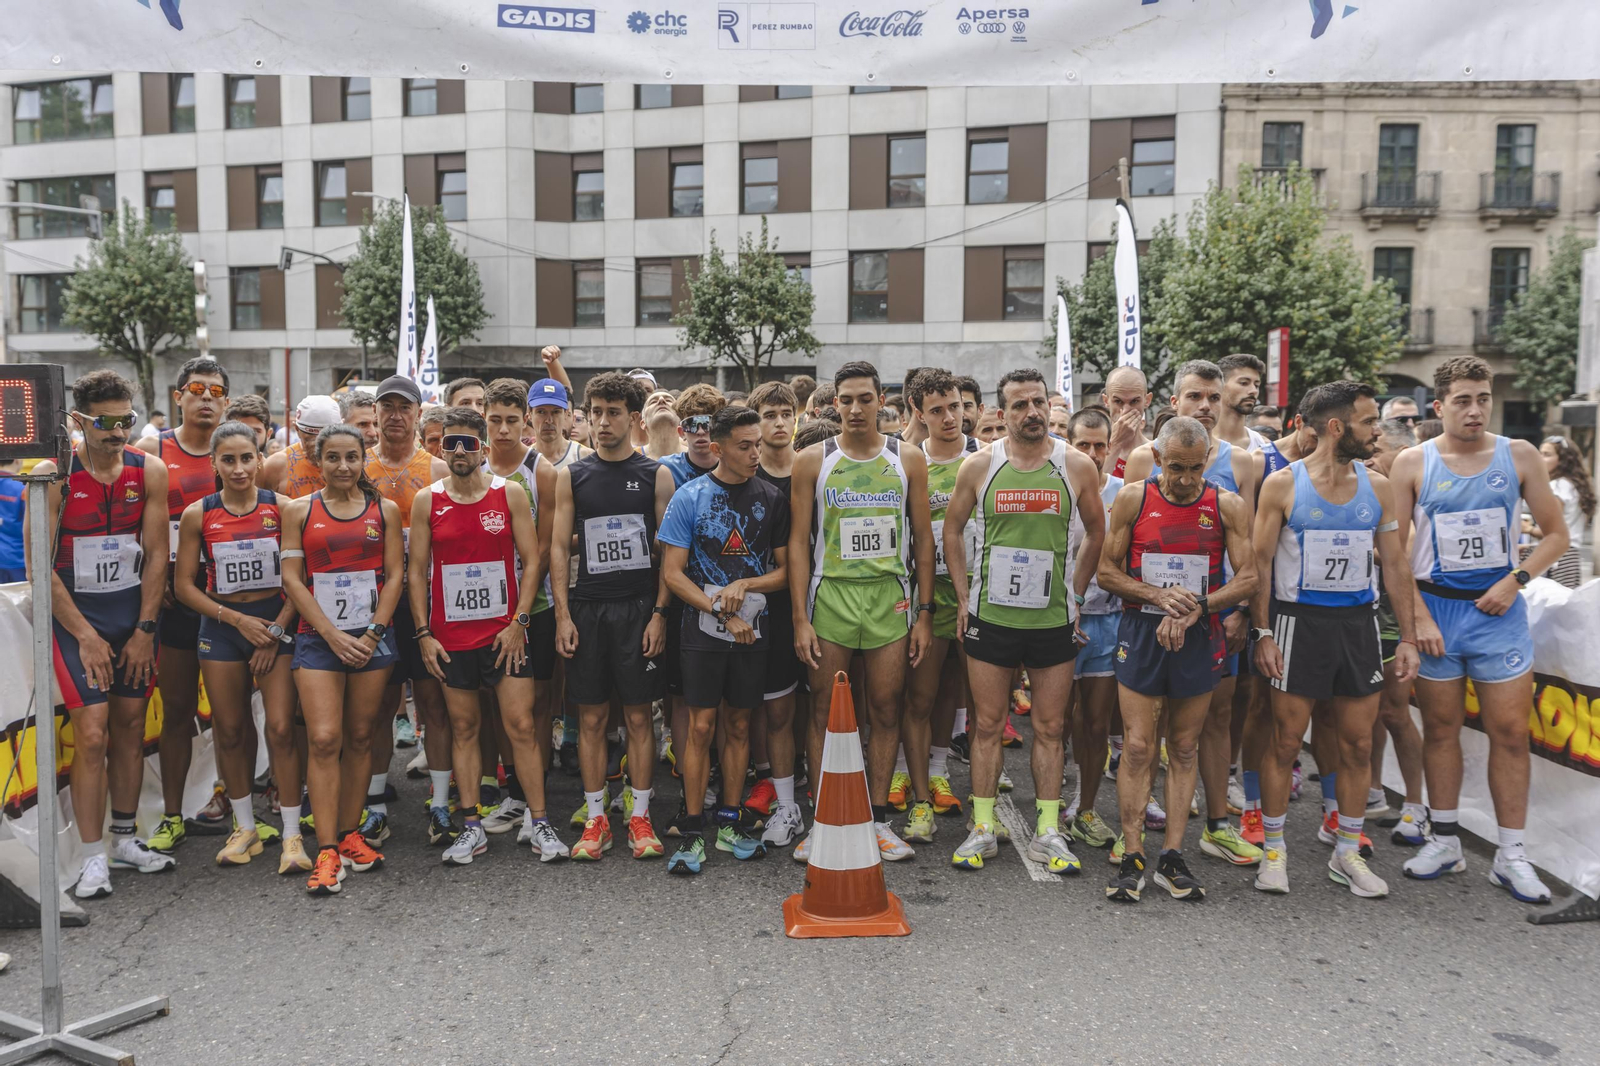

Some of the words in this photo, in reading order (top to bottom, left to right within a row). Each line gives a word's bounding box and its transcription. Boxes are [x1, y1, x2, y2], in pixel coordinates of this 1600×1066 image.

[502, 8, 592, 29] GADIS
[654, 10, 687, 27] chc
[956, 7, 1029, 23] Apersa
[654, 27, 687, 37] energía
[752, 22, 777, 31] PÉREZ
[826, 488, 902, 508] Natursueño
[997, 490, 1058, 502] mandarina
[997, 502, 1026, 512] home
[597, 539, 633, 563] 685
[852, 534, 881, 552] 903
[1458, 536, 1484, 560] 29
[95, 561, 120, 584] 112
[226, 560, 264, 583] 668
[1009, 565, 1024, 573] JAVI
[1155, 572, 1189, 580] SATURNINO
[1324, 558, 1350, 581] 27
[1009, 574, 1021, 597] 5
[336, 599, 348, 620] 2
[455, 588, 491, 611] 488
